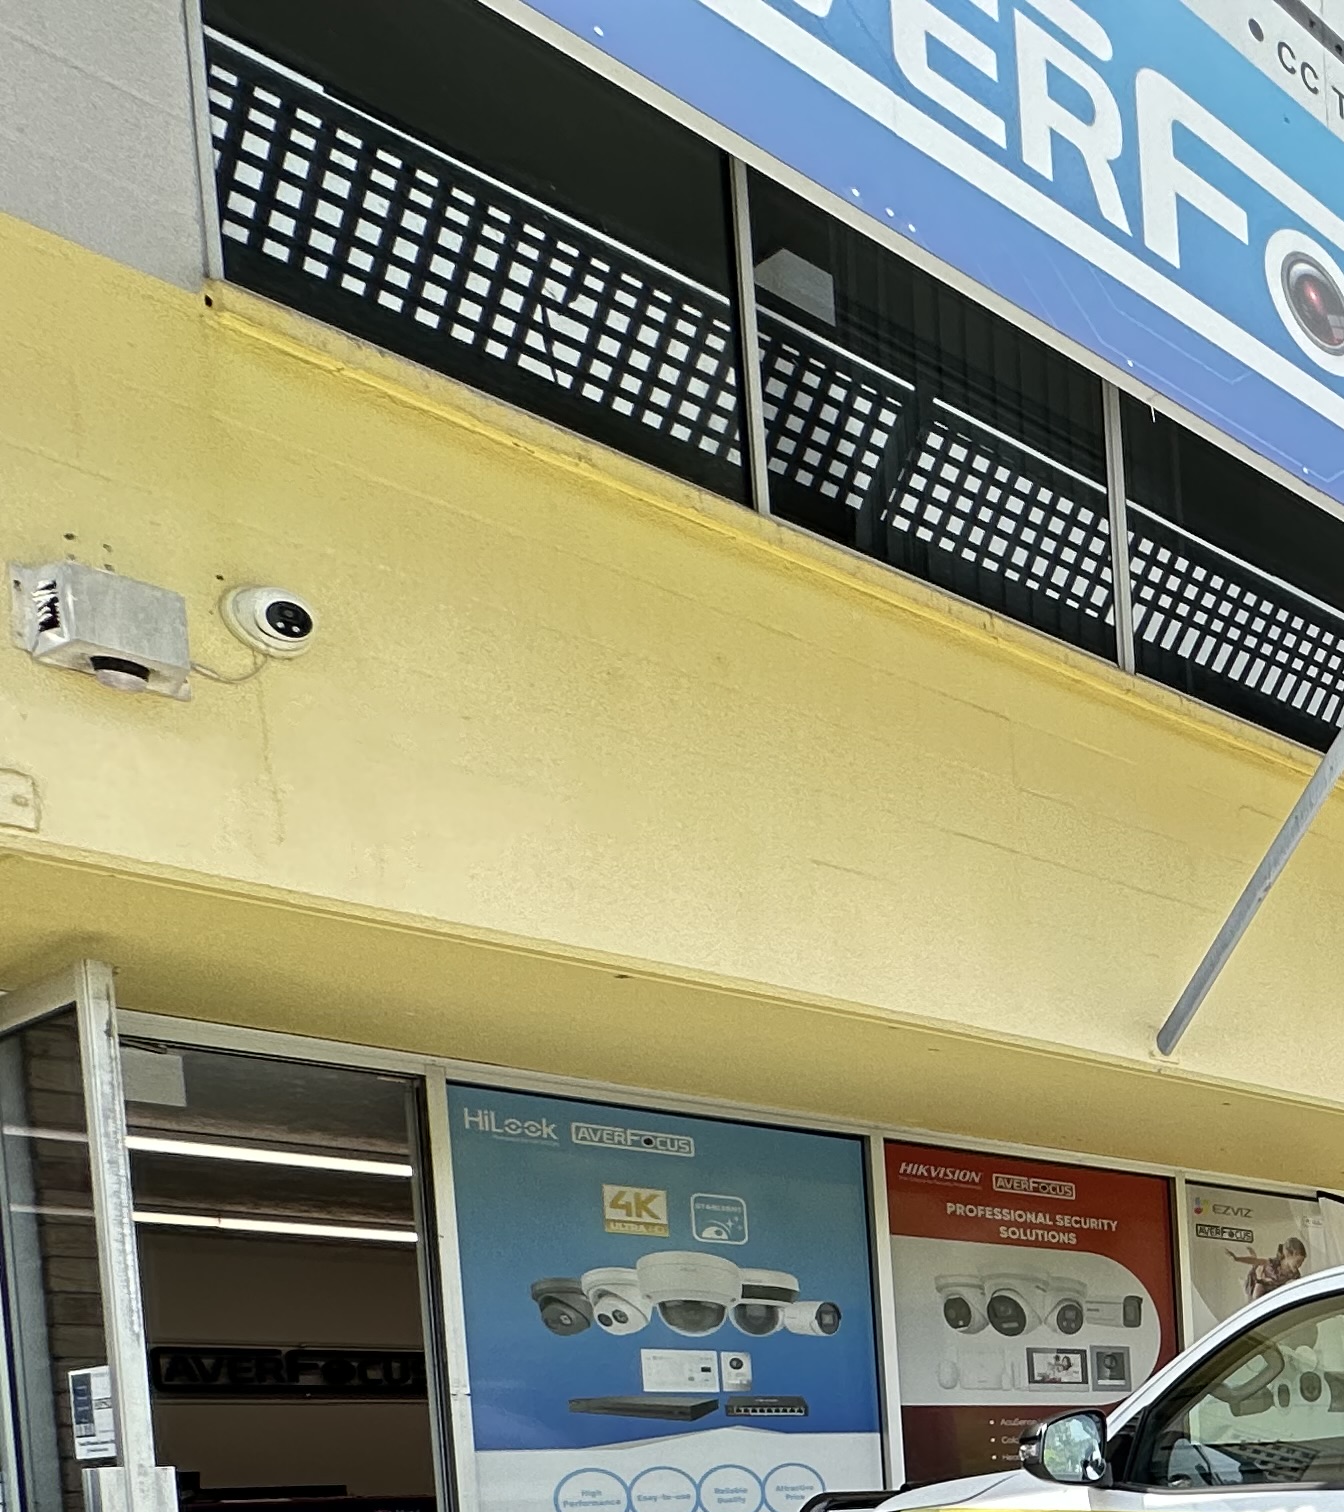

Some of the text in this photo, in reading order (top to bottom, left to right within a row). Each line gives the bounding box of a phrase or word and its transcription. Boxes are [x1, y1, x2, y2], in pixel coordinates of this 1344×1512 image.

[462, 1107, 558, 1140] HiLook
[576, 1126, 692, 1154] AVERFOCUS
[899, 1162, 982, 1184] HIKVISION
[996, 1176, 1073, 1198] AVERFOCUS
[609, 1190, 662, 1220] 4K
[946, 1202, 1118, 1232] PROFESSIONAL SECURITY
[1212, 1203, 1253, 1219] EZVIZ
[999, 1226, 1078, 1245] SOLUTIONS
